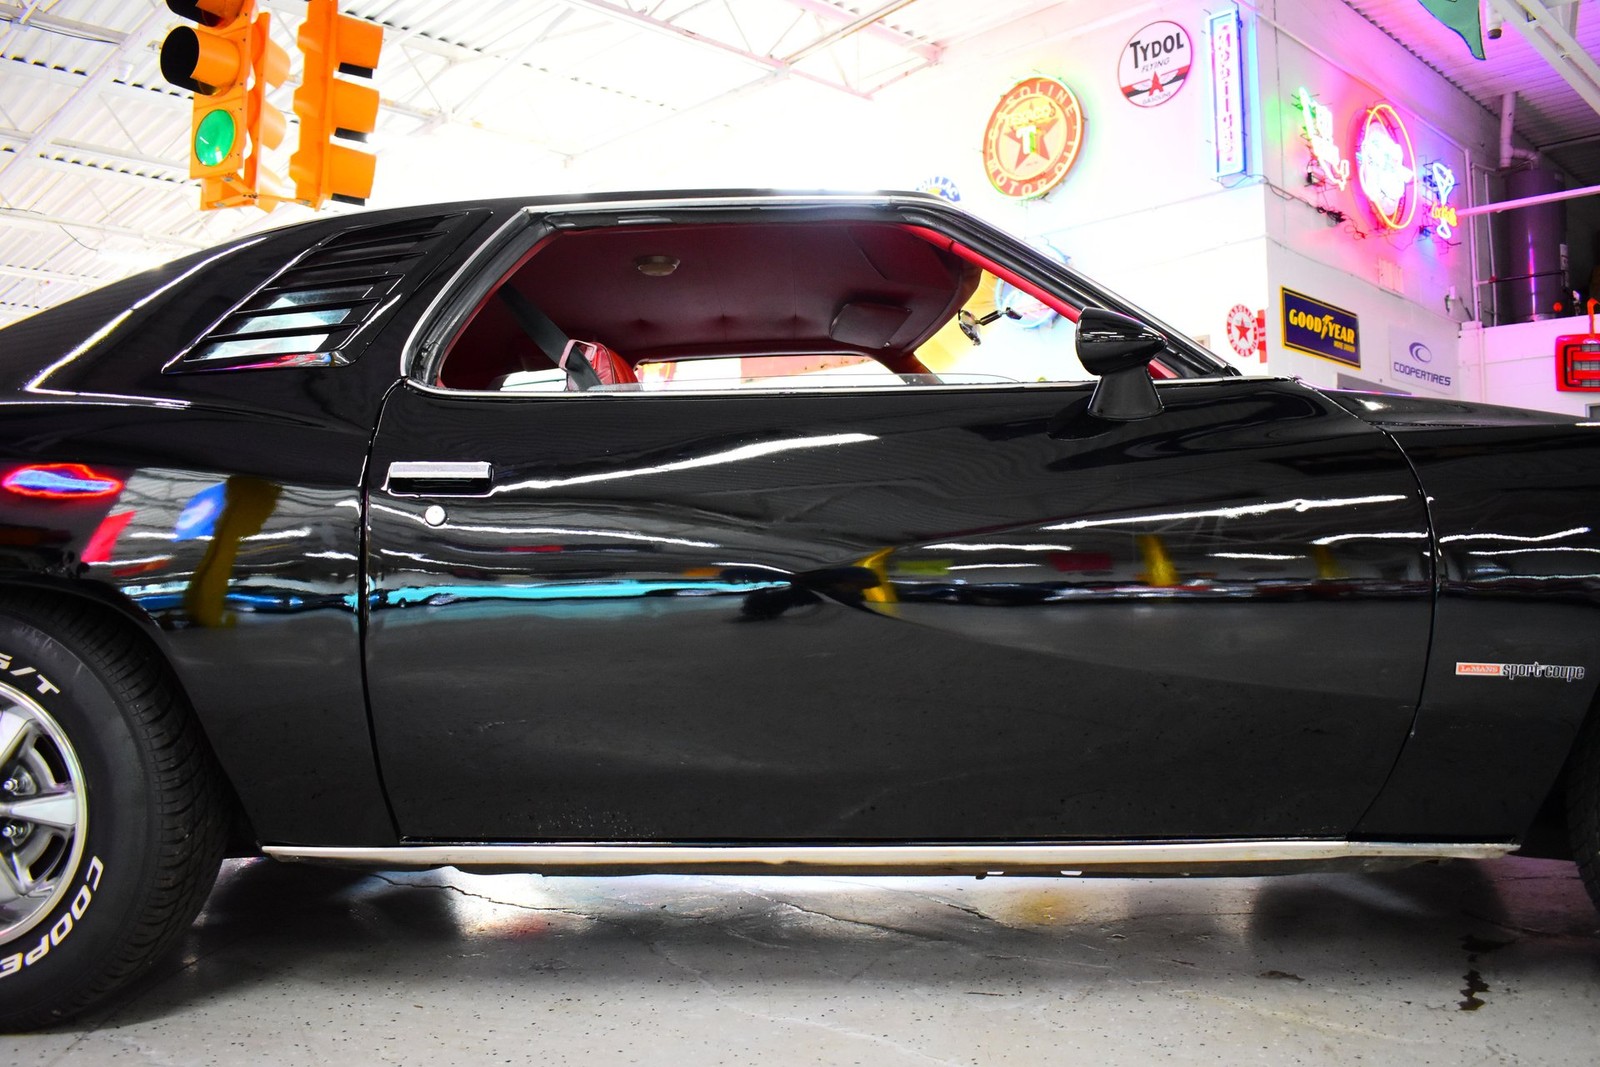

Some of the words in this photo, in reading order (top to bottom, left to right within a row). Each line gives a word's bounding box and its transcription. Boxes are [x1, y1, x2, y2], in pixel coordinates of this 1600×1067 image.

[1129, 32, 1185, 69] TYDOL
[1141, 57, 1170, 73] FLYING
[986, 161, 1049, 197] MOTOR
[1054, 140, 1076, 176] OIL
[1288, 308, 1356, 344] GOODYEAR
[1393, 361, 1452, 387] COOPERTIRES
[1502, 662, 1542, 680] sport
[1544, 664, 1585, 682] coupe
